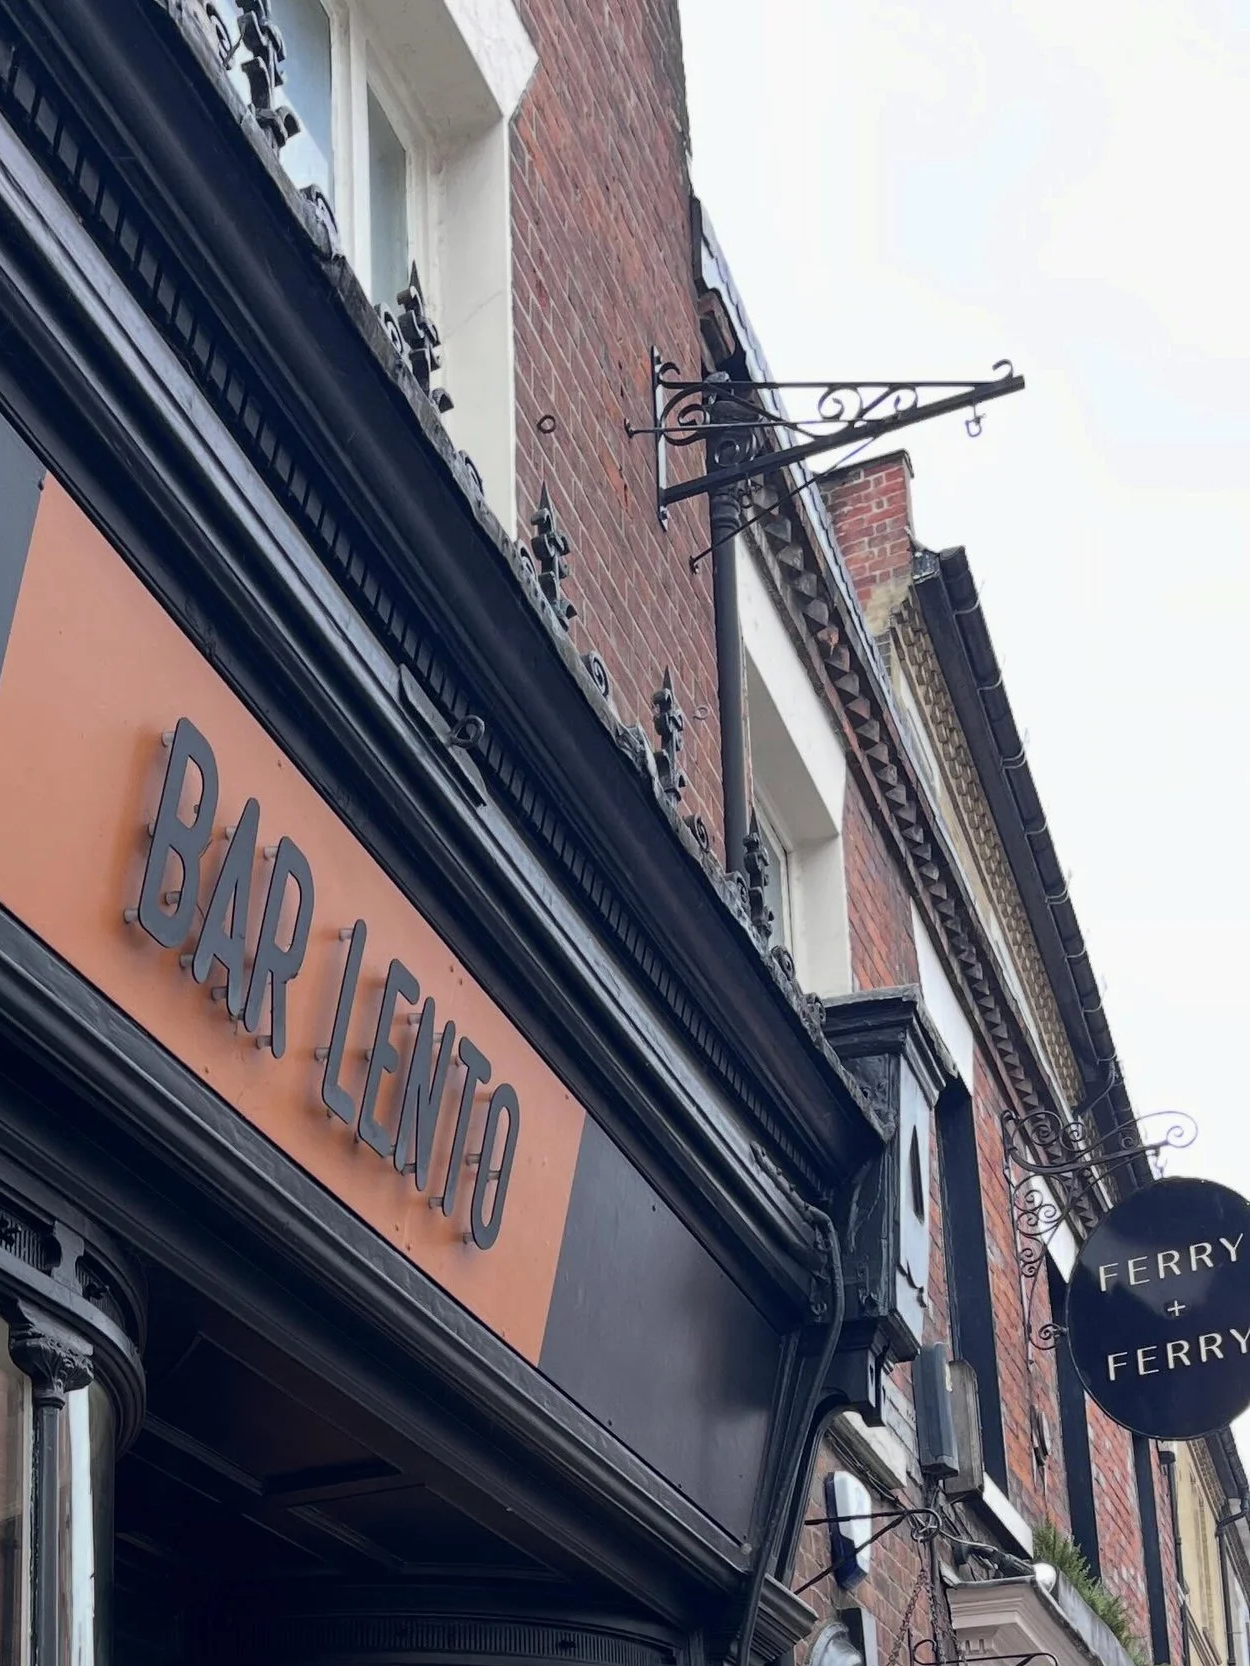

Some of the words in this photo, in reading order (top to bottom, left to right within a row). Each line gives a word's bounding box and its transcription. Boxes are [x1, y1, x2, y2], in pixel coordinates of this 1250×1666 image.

[138, 717, 316, 1058] BAR
[322, 919, 520, 1250] LENTO
[1099, 1233, 1244, 1293] FERRY
[1107, 1328, 1250, 1381] FERRY
